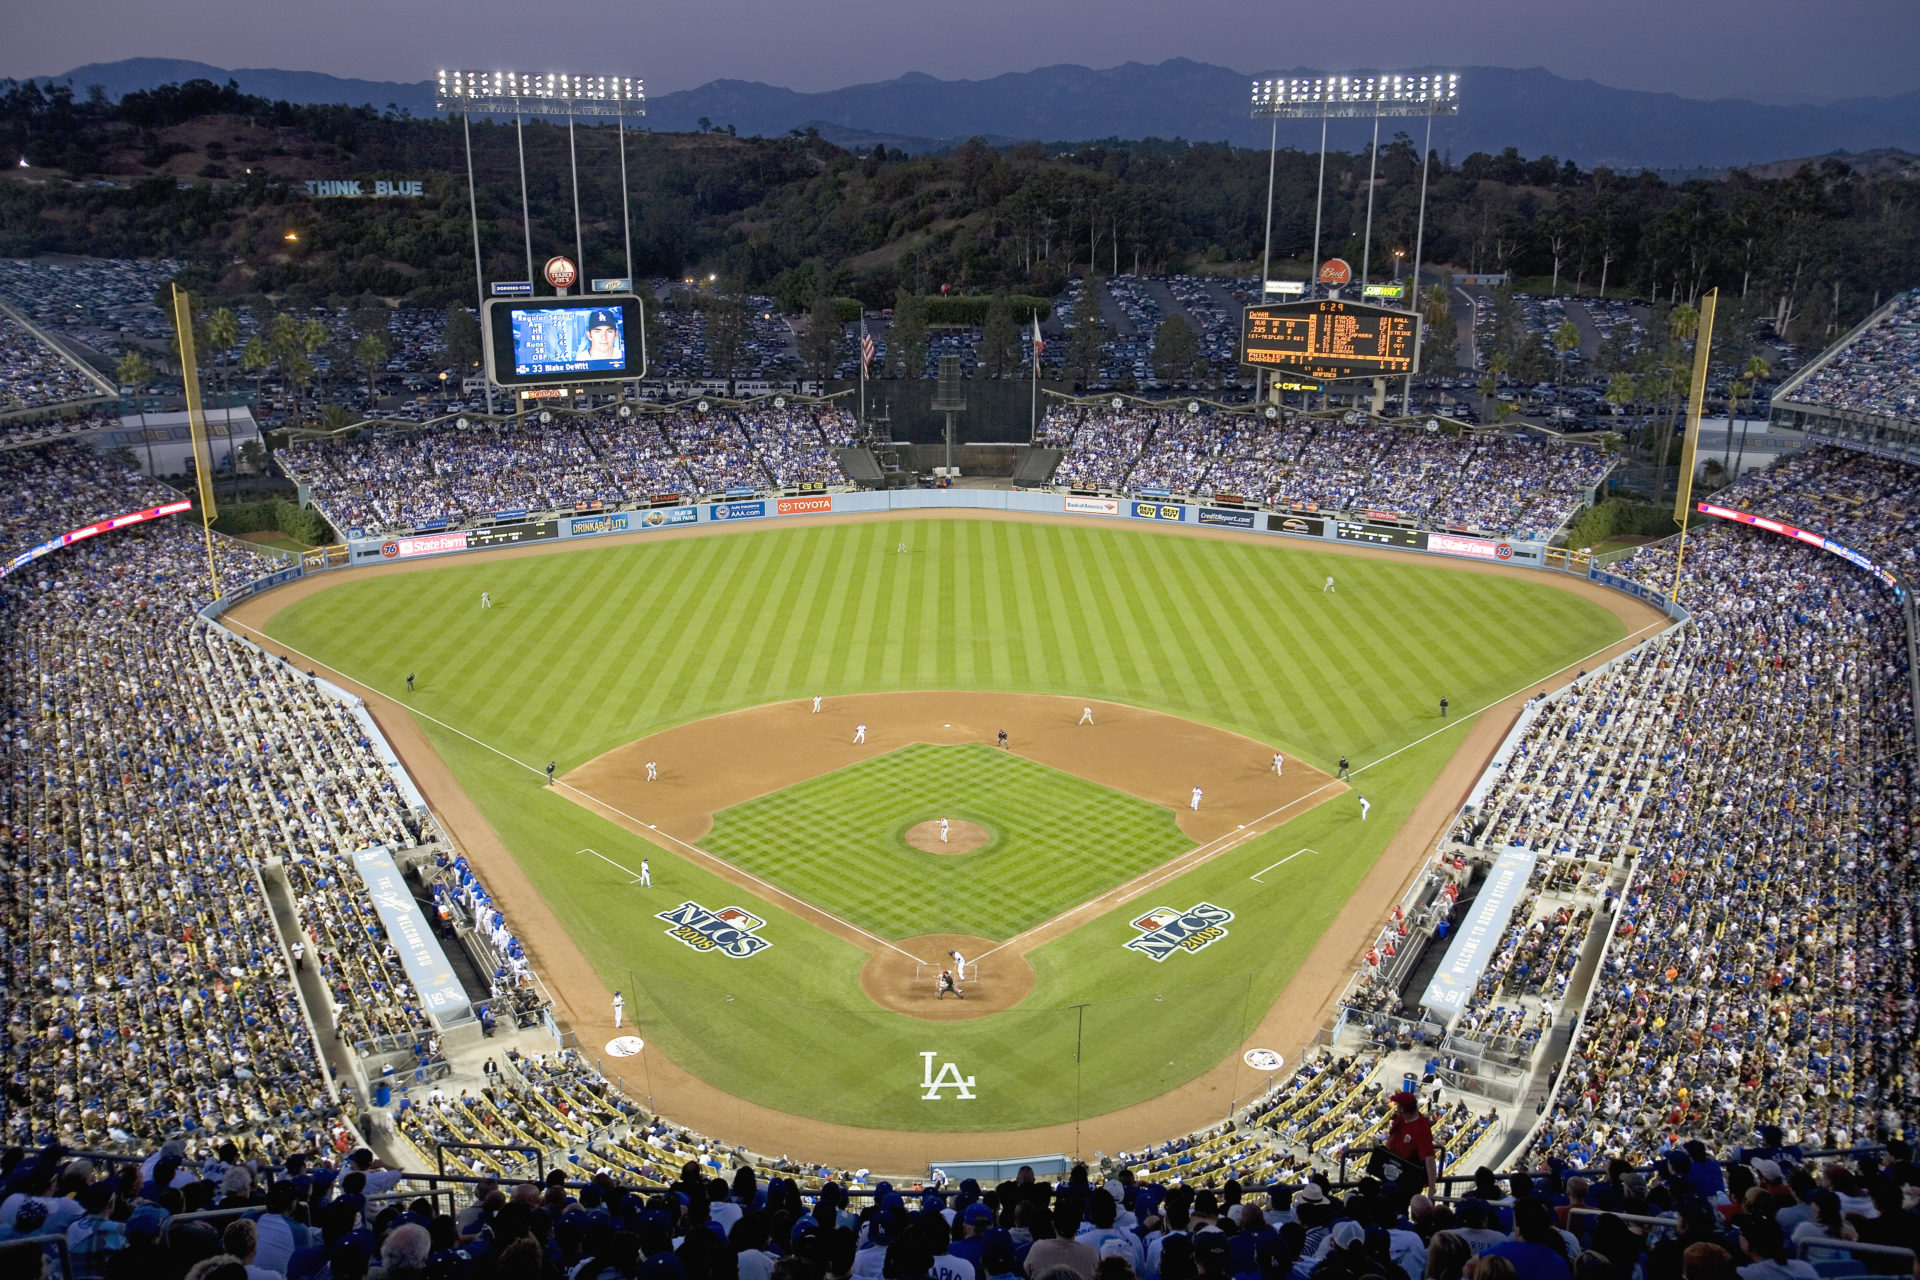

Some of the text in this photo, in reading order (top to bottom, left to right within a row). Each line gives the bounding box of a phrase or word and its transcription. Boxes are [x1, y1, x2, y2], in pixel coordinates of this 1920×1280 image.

[304, 180, 424, 196] THINK BLUE
[1320, 266, 1346, 278] Bud
[1364, 286, 1402, 297] SUBWAY
[1320, 302, 1344, 312] 6:29
[598, 312, 606, 322] LA
[1249, 310, 1269, 318] DeWitt
[532, 364, 542, 372] 33
[566, 362, 589, 370] DeWitt
[1282, 382, 1301, 390] CPK
[793, 500, 830, 510] TOYOTA
[1200, 512, 1251, 523] CreditReport.com
[573, 518, 626, 534] DRINKABLITY
[384, 544, 396, 554] 76
[414, 539, 440, 552] State
[440, 537, 466, 549] Farm
[1444, 538, 1495, 555] State Farm
[1498, 547, 1510, 556] 76
[376, 876, 392, 888] THE
[396, 914, 424, 950] WELCOME
[414, 948, 433, 966] YOU
[1451, 870, 1516, 974] WELCOME TO DODGER STADIUM
[657, 901, 770, 957] NLCS
[1125, 903, 1233, 960] NLCS
[671, 926, 716, 950] 2008
[1180, 926, 1224, 950] 2008
[920, 1051, 976, 1100] LA
